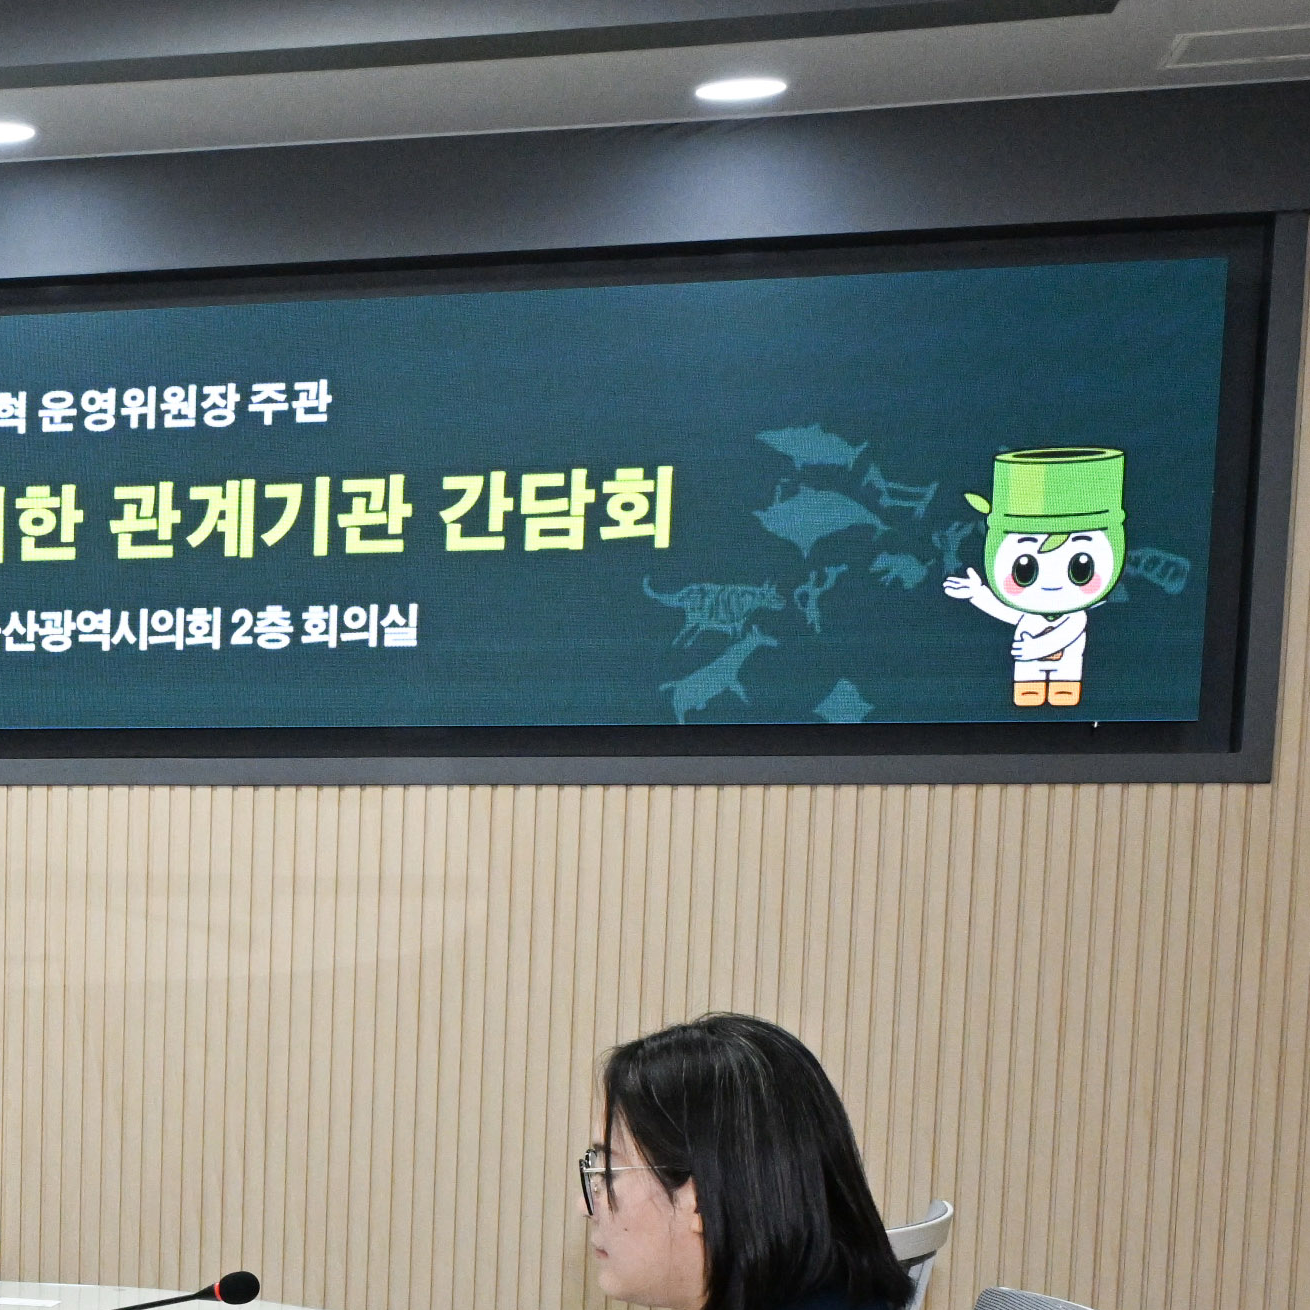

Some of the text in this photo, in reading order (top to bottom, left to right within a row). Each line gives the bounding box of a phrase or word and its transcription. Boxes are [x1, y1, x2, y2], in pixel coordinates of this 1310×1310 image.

[37, 382, 241, 434] 운영위원장
[247, 378, 333, 426] 주관
[109, 472, 413, 561] 관계기관
[438, 464, 674, 553] 간담회
[230, 604, 294, 650] 2층
[300, 602, 419, 649] 회의실
